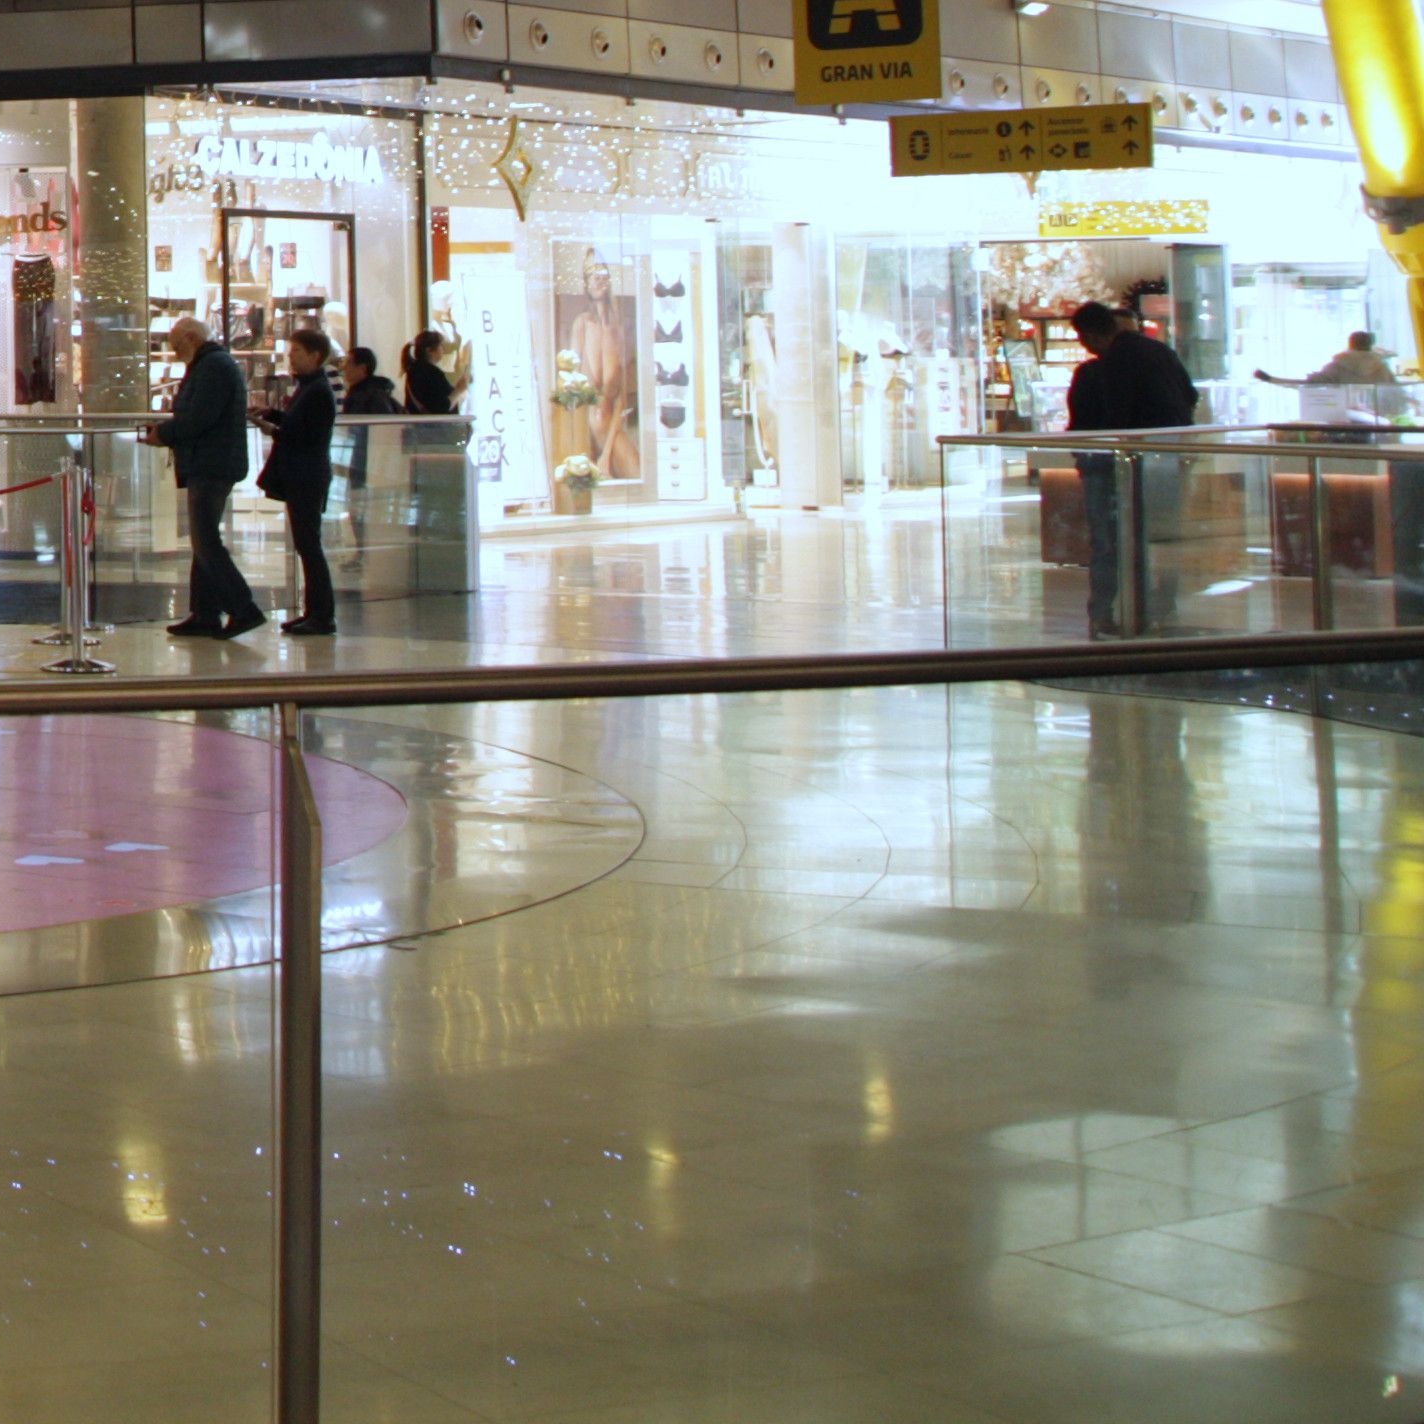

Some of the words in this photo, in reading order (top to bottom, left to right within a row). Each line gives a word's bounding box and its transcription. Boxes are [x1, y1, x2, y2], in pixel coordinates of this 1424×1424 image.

[821, 64, 873, 83] GRAN
[879, 62, 912, 79] VIA
[194, 135, 383, 183] CALZEDONIA
